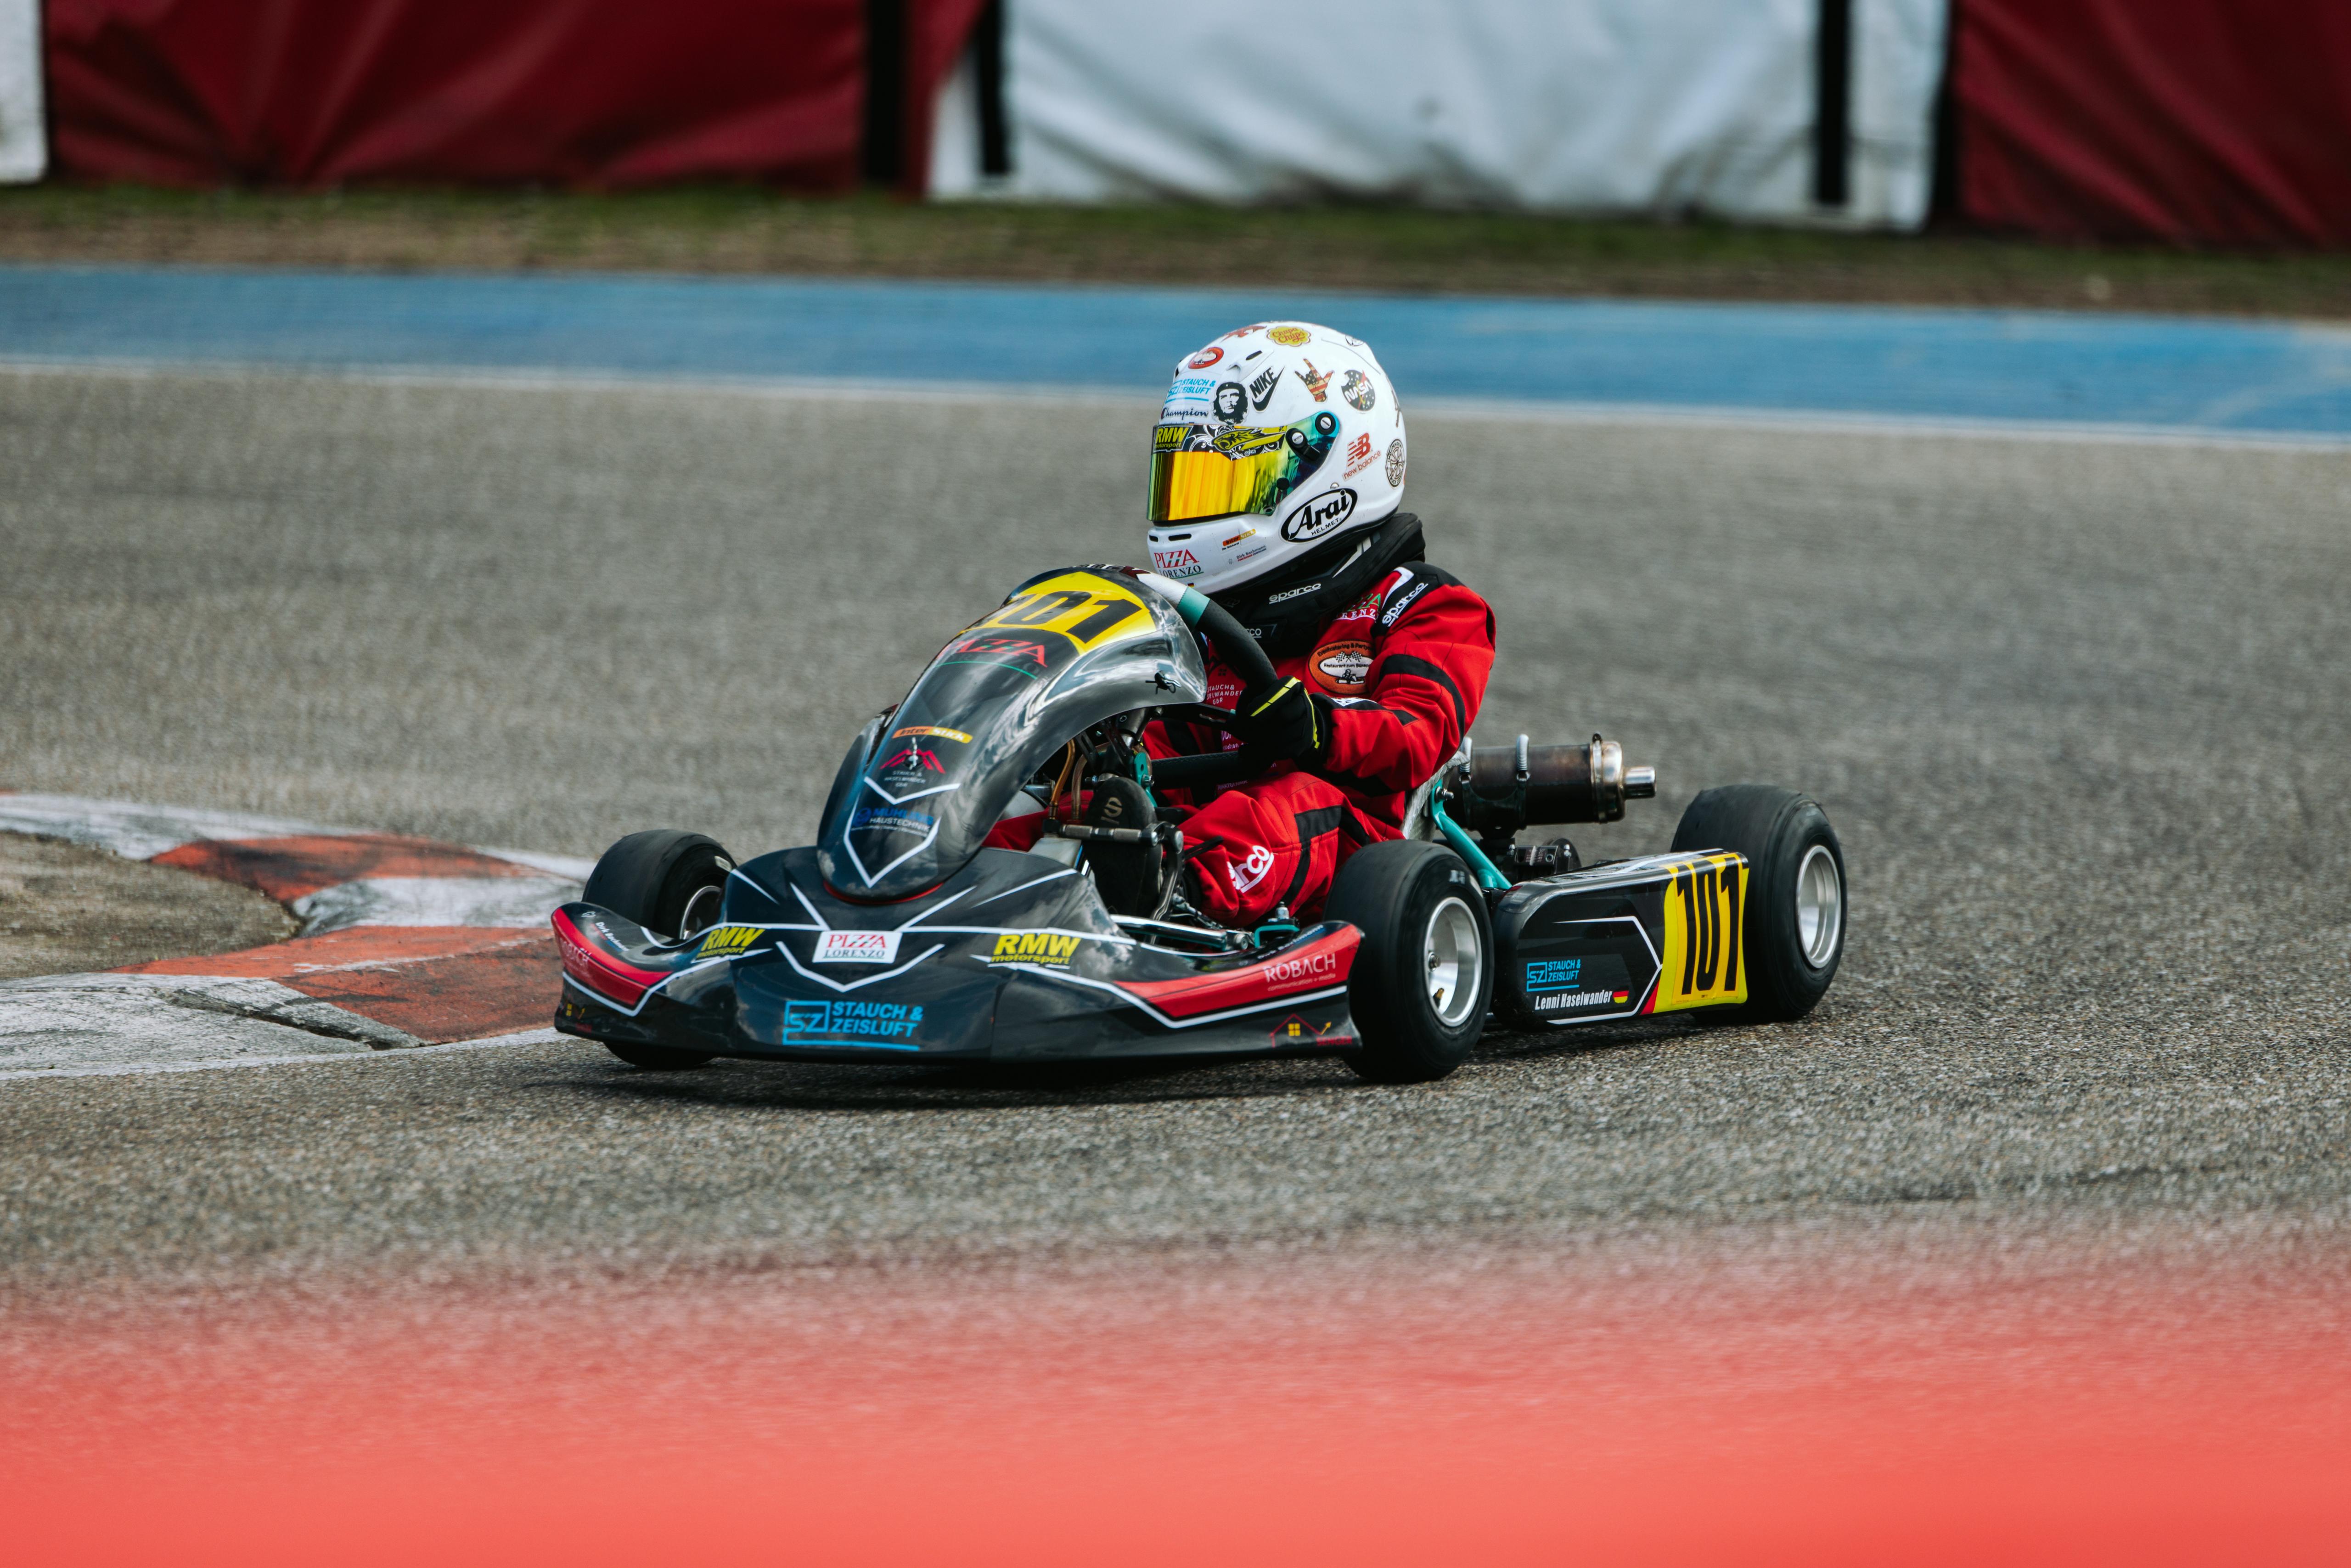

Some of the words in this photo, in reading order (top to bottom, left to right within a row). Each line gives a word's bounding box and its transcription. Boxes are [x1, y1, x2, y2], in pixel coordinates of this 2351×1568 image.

[1249, 367, 1277, 399] NIKE
[1344, 379, 1372, 402] NASA
[1161, 407, 1208, 420] Champion
[1156, 427, 1189, 443] RMW
[1344, 468, 1357, 479] new
[1357, 450, 1381, 471] balance
[1288, 489, 1350, 540] Arai
[1311, 517, 1339, 536] HELMET
[1154, 549, 1199, 568] PIZZA
[1269, 583, 1322, 604] sparco
[1382, 583, 1428, 627] sparco
[869, 817, 931, 832] HAUSTECHNIK
[1676, 857, 1739, 995] 101
[701, 927, 766, 951] RMW
[827, 933, 887, 949] PIZZA
[993, 933, 1082, 957] RMW
[696, 947, 746, 959] motorsport
[825, 949, 885, 958] LORENZO
[991, 954, 1070, 964] motorsport
[1264, 953, 1336, 983] ROBACH
[1548, 960, 1576, 971] STAUCH
[1576, 959, 1581, 969] &
[1547, 970, 1580, 982] ZEISLUFT
[1535, 994, 1560, 1011] Lenni
[1560, 989, 1613, 1008] Haselwander
[832, 1000, 908, 1020] STAUCH
[910, 1006, 924, 1022] &
[830, 1018, 918, 1038] ZEISLUFT
